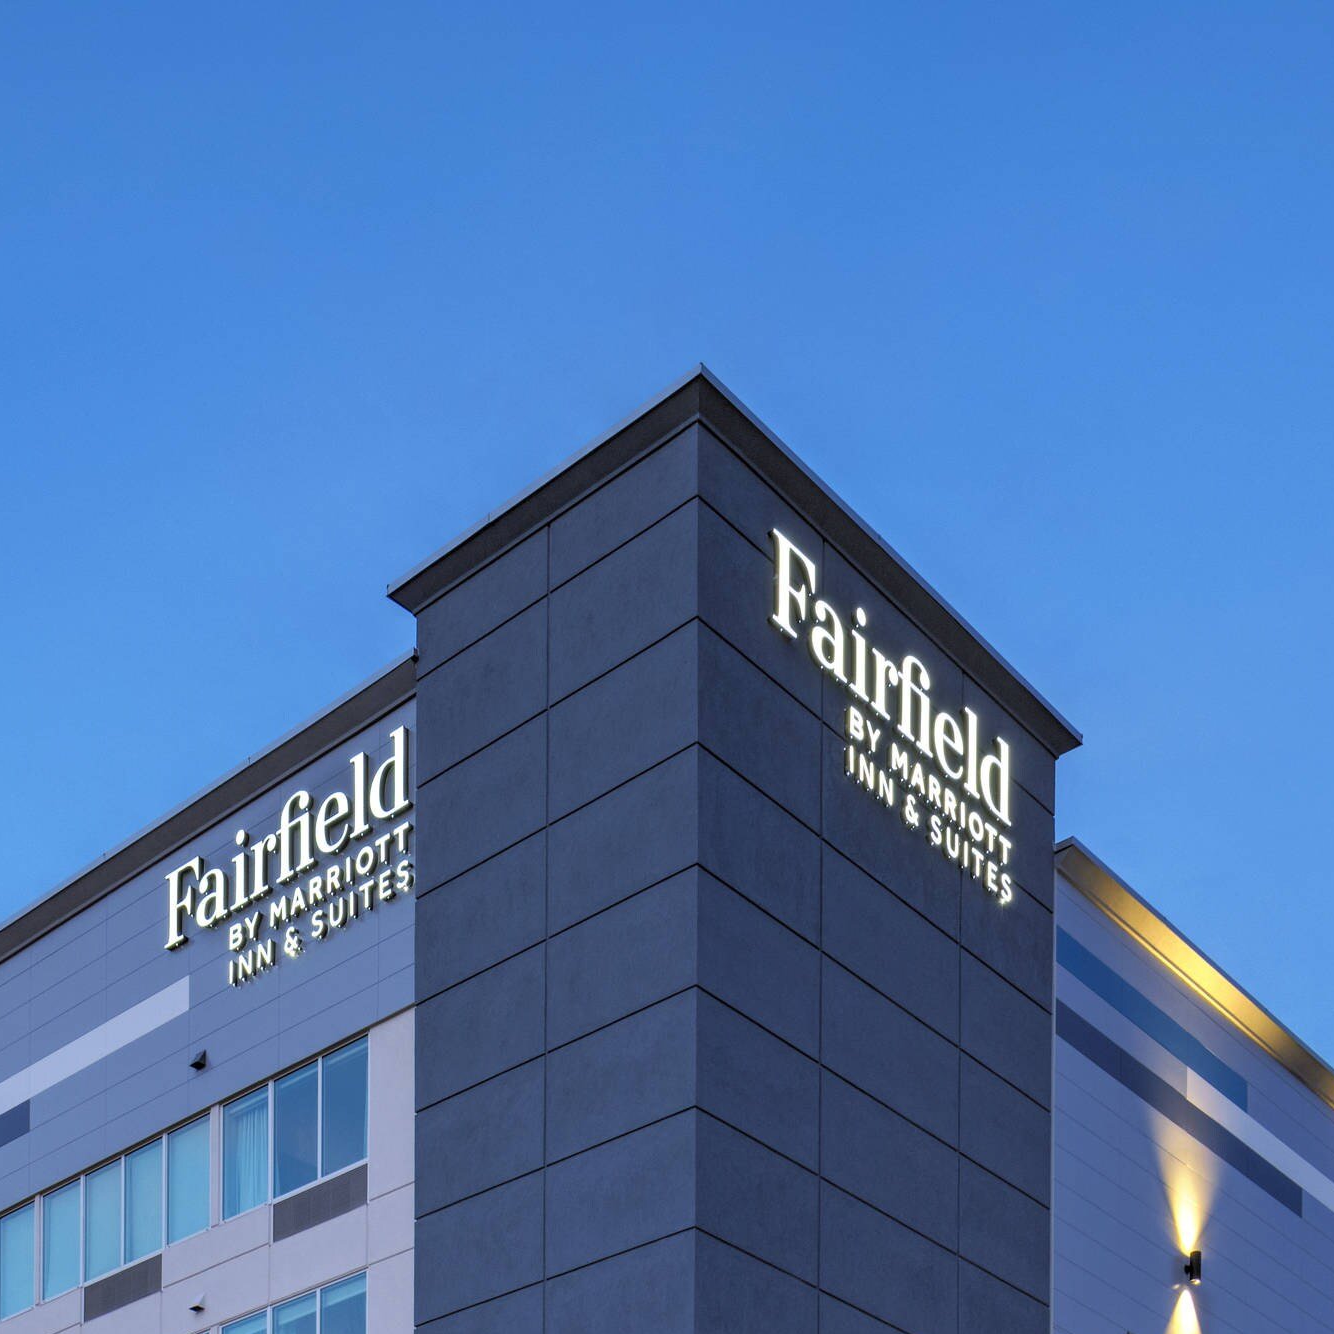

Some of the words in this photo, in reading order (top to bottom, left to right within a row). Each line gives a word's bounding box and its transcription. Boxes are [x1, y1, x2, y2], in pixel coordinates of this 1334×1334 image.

[771, 528, 1012, 827] Fairfield
[164, 725, 414, 950] Fairfield
[847, 705, 881, 753] BY
[890, 742, 1013, 866] MARRIOTT
[847, 745, 894, 807] INN
[902, 795, 920, 828] &
[929, 815, 1014, 903] SUITES
[228, 911, 261, 951] BY
[269, 821, 414, 930] MARRIOTT
[228, 938, 276, 987] INN
[283, 926, 303, 959] &
[310, 860, 415, 940] SUITES
